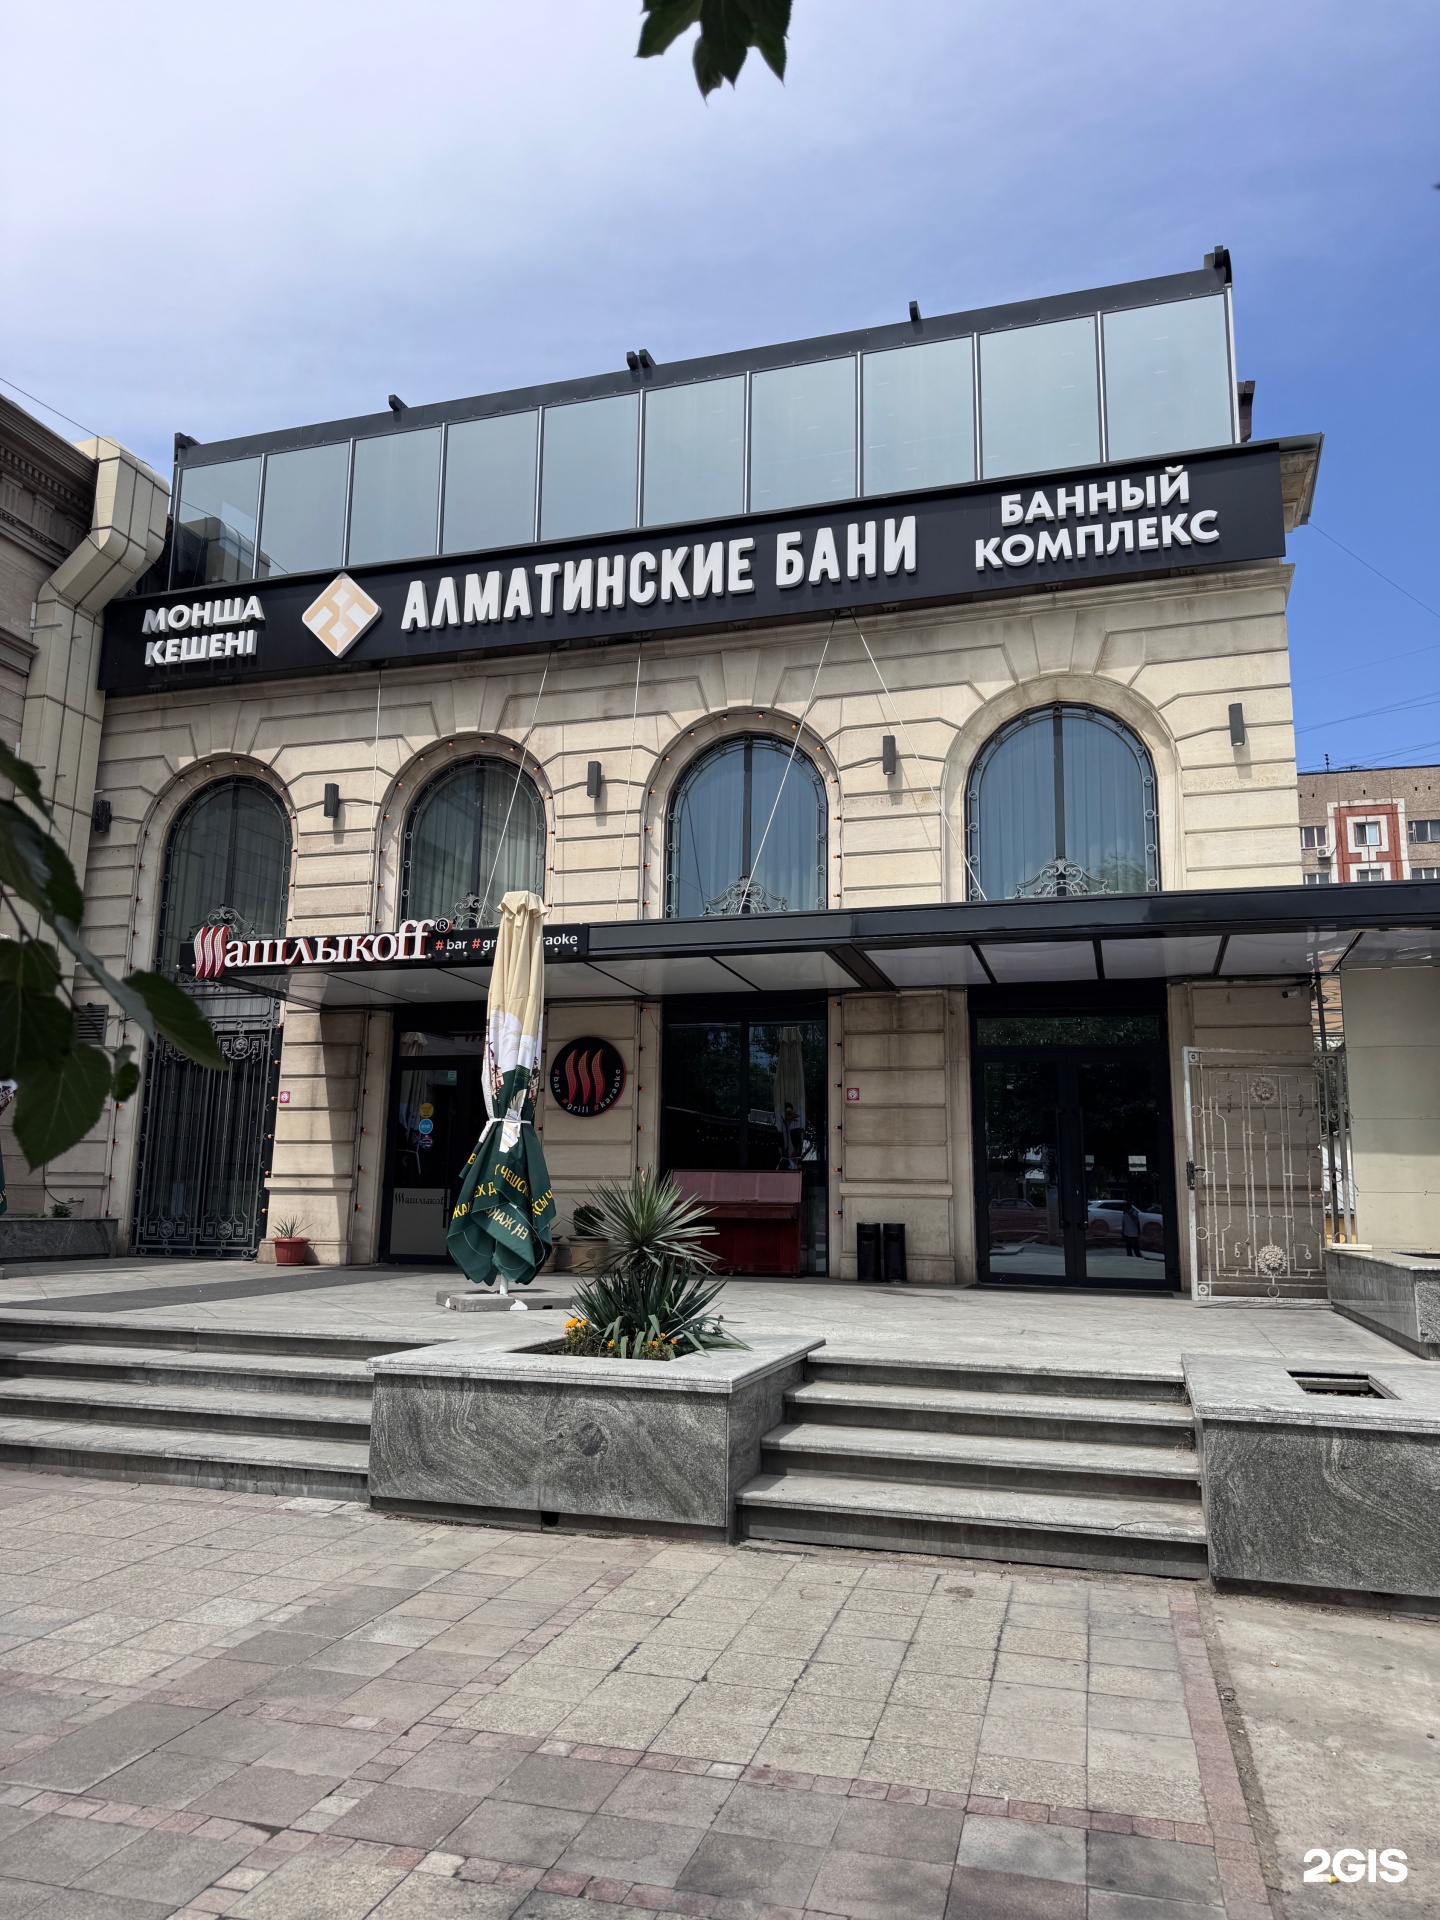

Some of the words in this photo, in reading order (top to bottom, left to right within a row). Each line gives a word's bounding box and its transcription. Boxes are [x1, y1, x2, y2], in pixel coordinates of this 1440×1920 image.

[1001, 465, 1190, 527] БАННЫЙ
[975, 510, 1220, 571] КОМПЛЕКС
[401, 537, 756, 633] АЛМАТИНСКИЕ
[775, 515, 917, 589] БАНИ
[142, 595, 265, 635] МОНША
[144, 629, 257, 667] КЕШЕНІ
[471, 938, 497, 952] #gr
